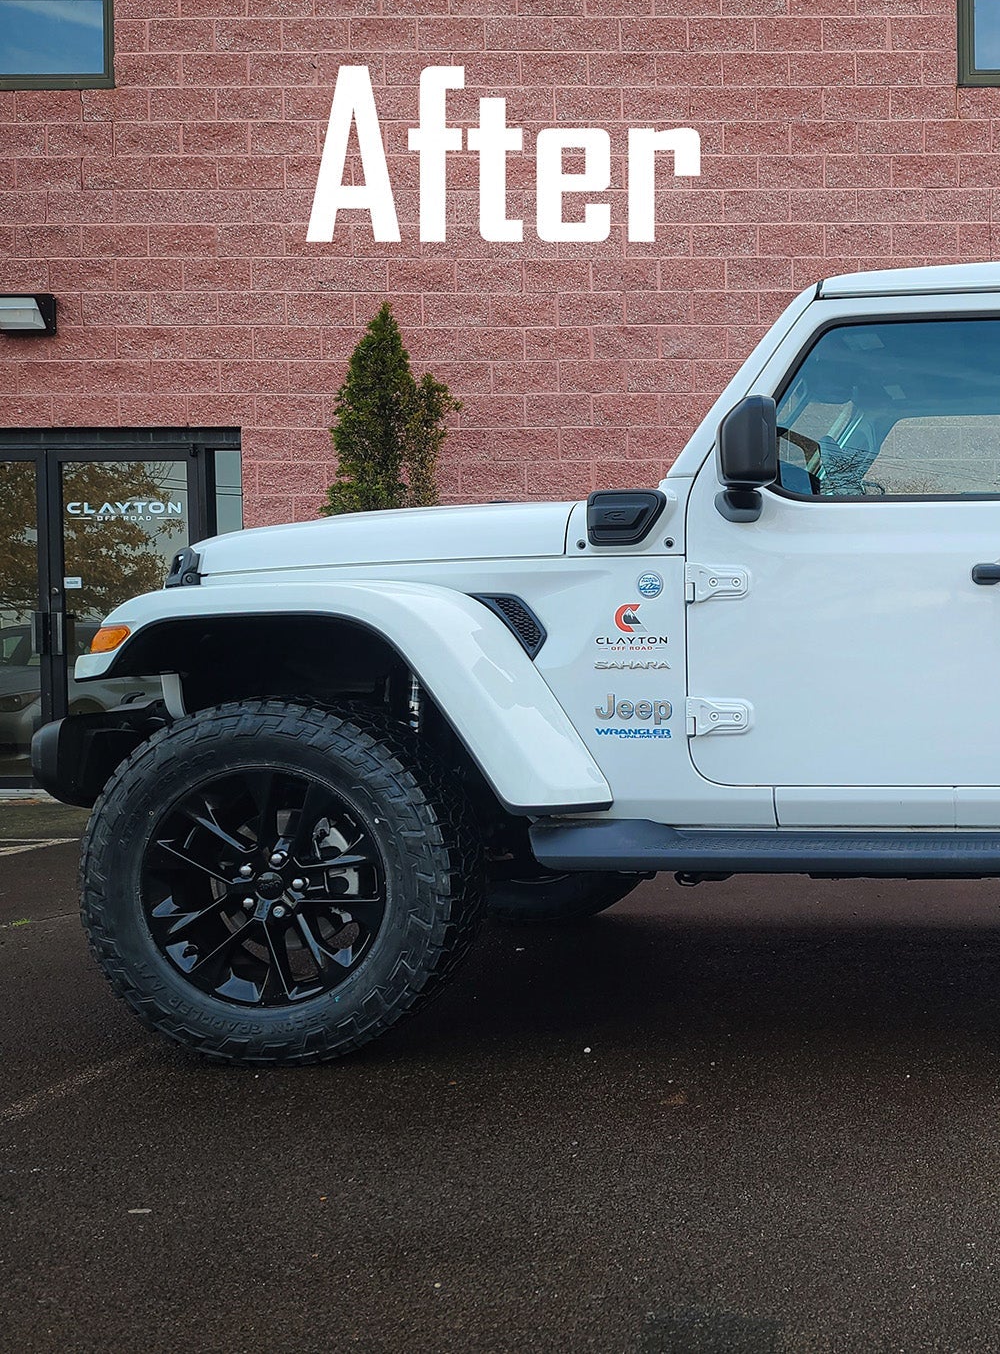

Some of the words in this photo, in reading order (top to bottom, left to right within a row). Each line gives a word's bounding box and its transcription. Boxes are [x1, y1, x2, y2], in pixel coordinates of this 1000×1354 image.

[66, 501, 182, 514] CLAYTON
[595, 636, 668, 645] CLAYTON
[594, 660, 671, 670] SAHARA
[595, 693, 672, 725] Jeep
